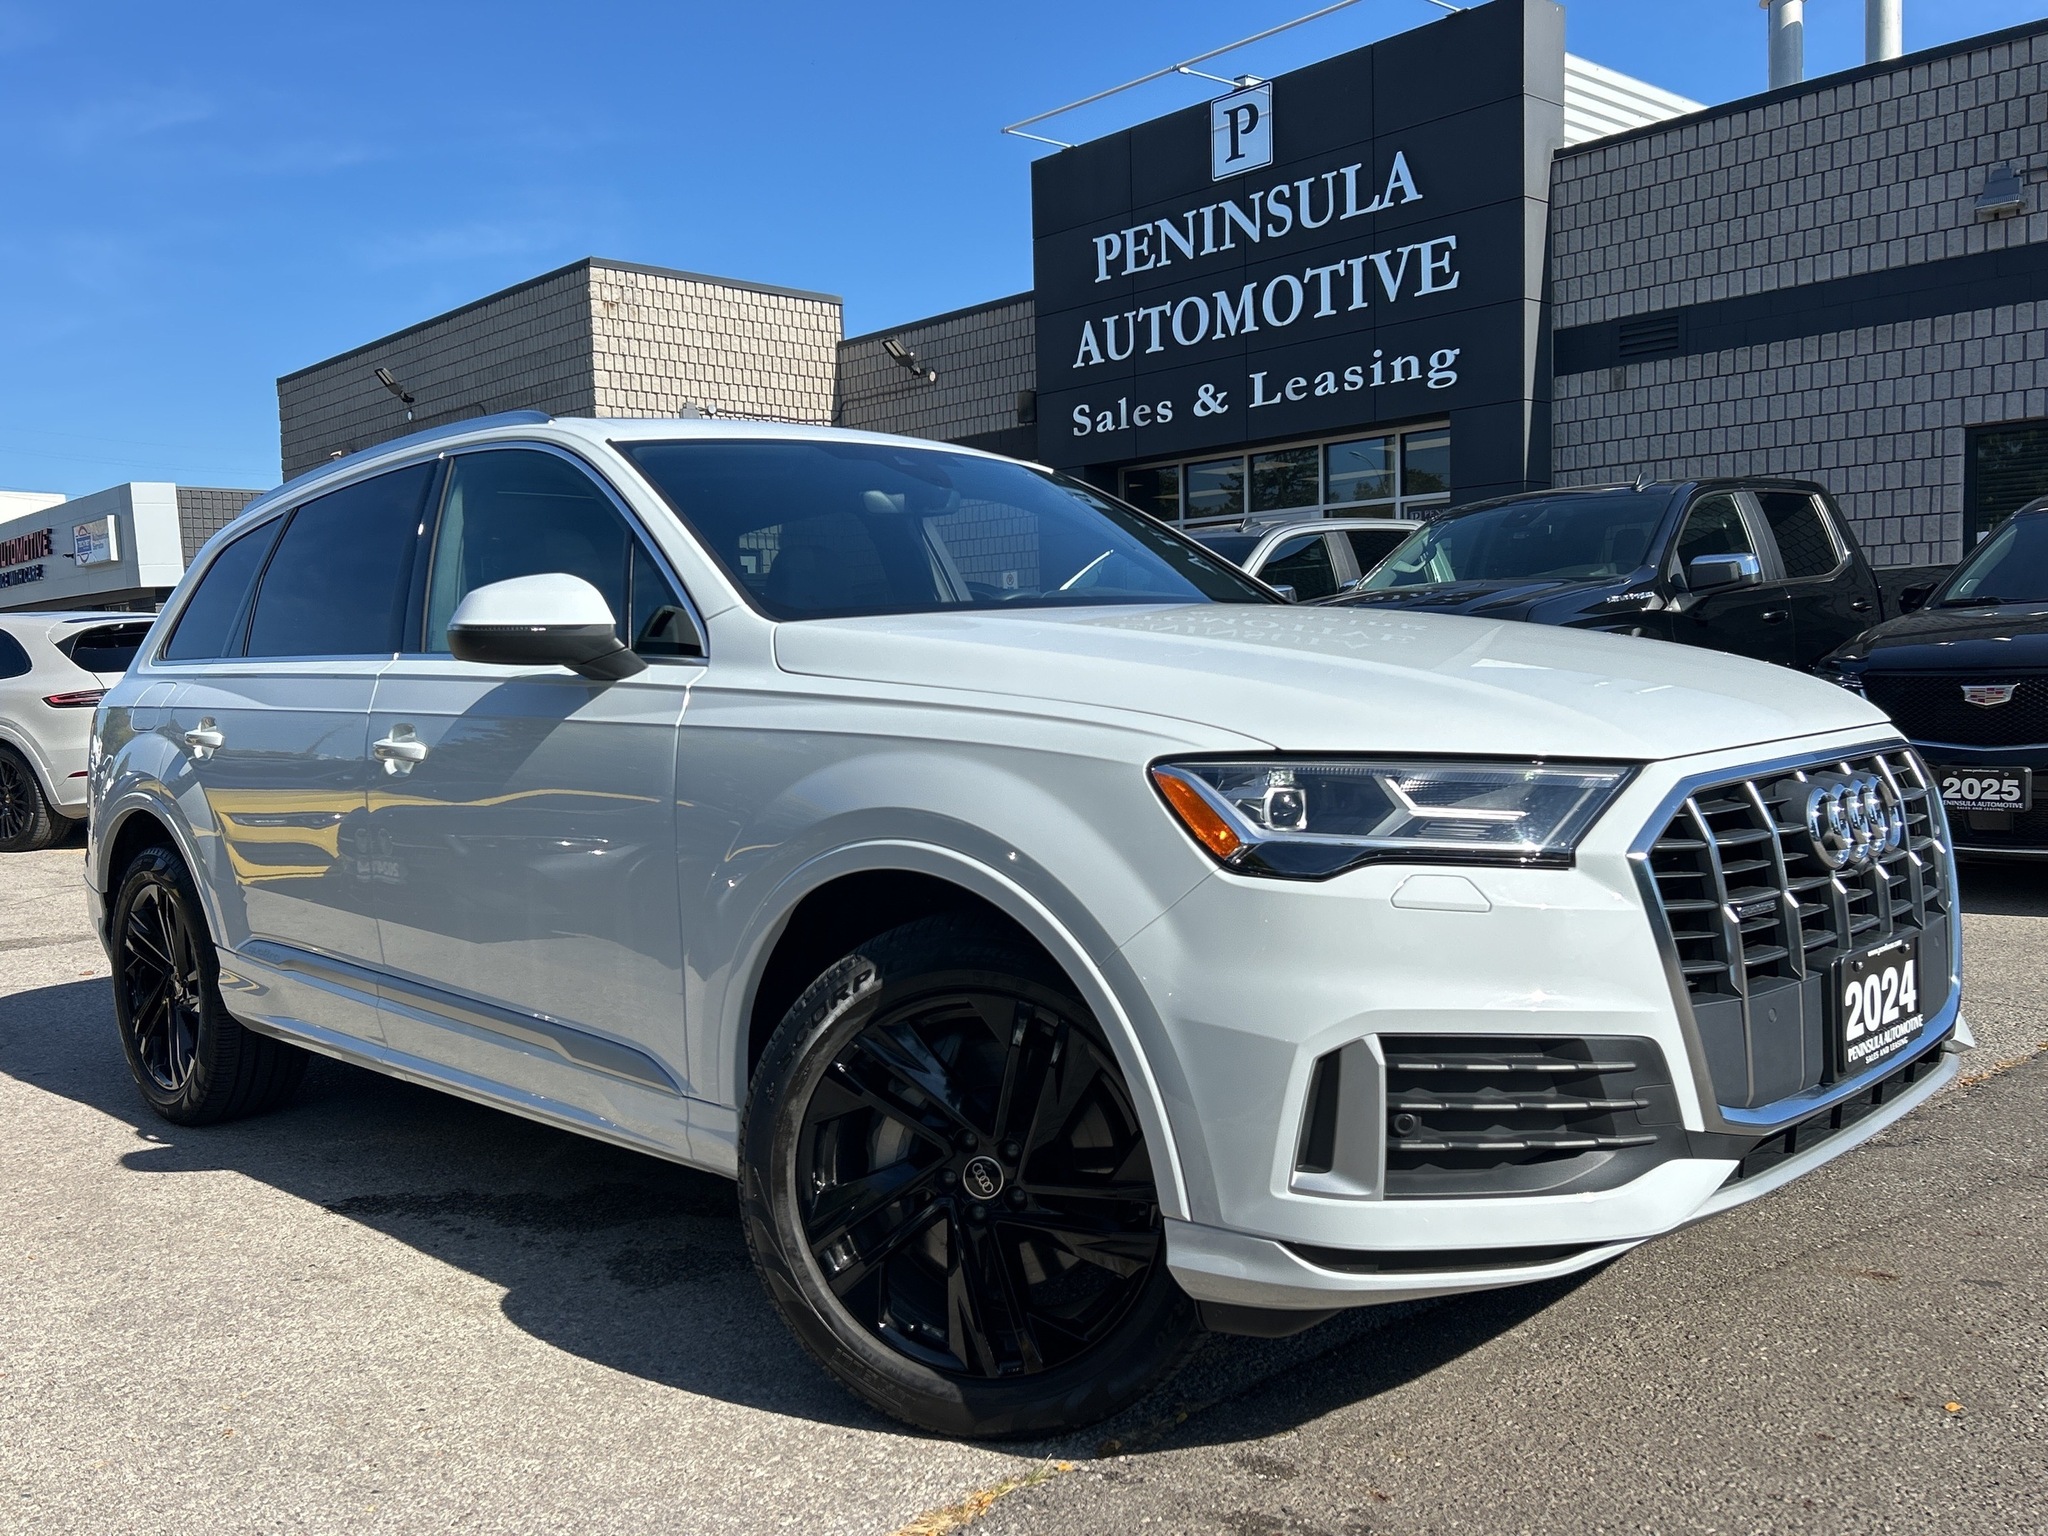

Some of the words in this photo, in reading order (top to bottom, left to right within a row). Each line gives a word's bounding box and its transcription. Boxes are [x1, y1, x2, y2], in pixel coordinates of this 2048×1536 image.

[1223, 103, 1259, 163] P
[1092, 151, 1423, 283] PENINSULA
[1072, 235, 1460, 369] AUTOMOTIVE
[1072, 397, 1173, 436] Sales
[1193, 383, 1229, 417] &
[1248, 347, 1460, 408] Leasing
[0, 528, 52, 568] UTOMOTIVE
[1942, 777, 2021, 801] 2025
[1977, 801, 2023, 809] AUTOMOTIVE
[1845, 959, 1917, 1041] 2024
[1848, 1034, 1884, 1062] PENINSULA
[1884, 1014, 1923, 1045] AUTOMOTIVE
